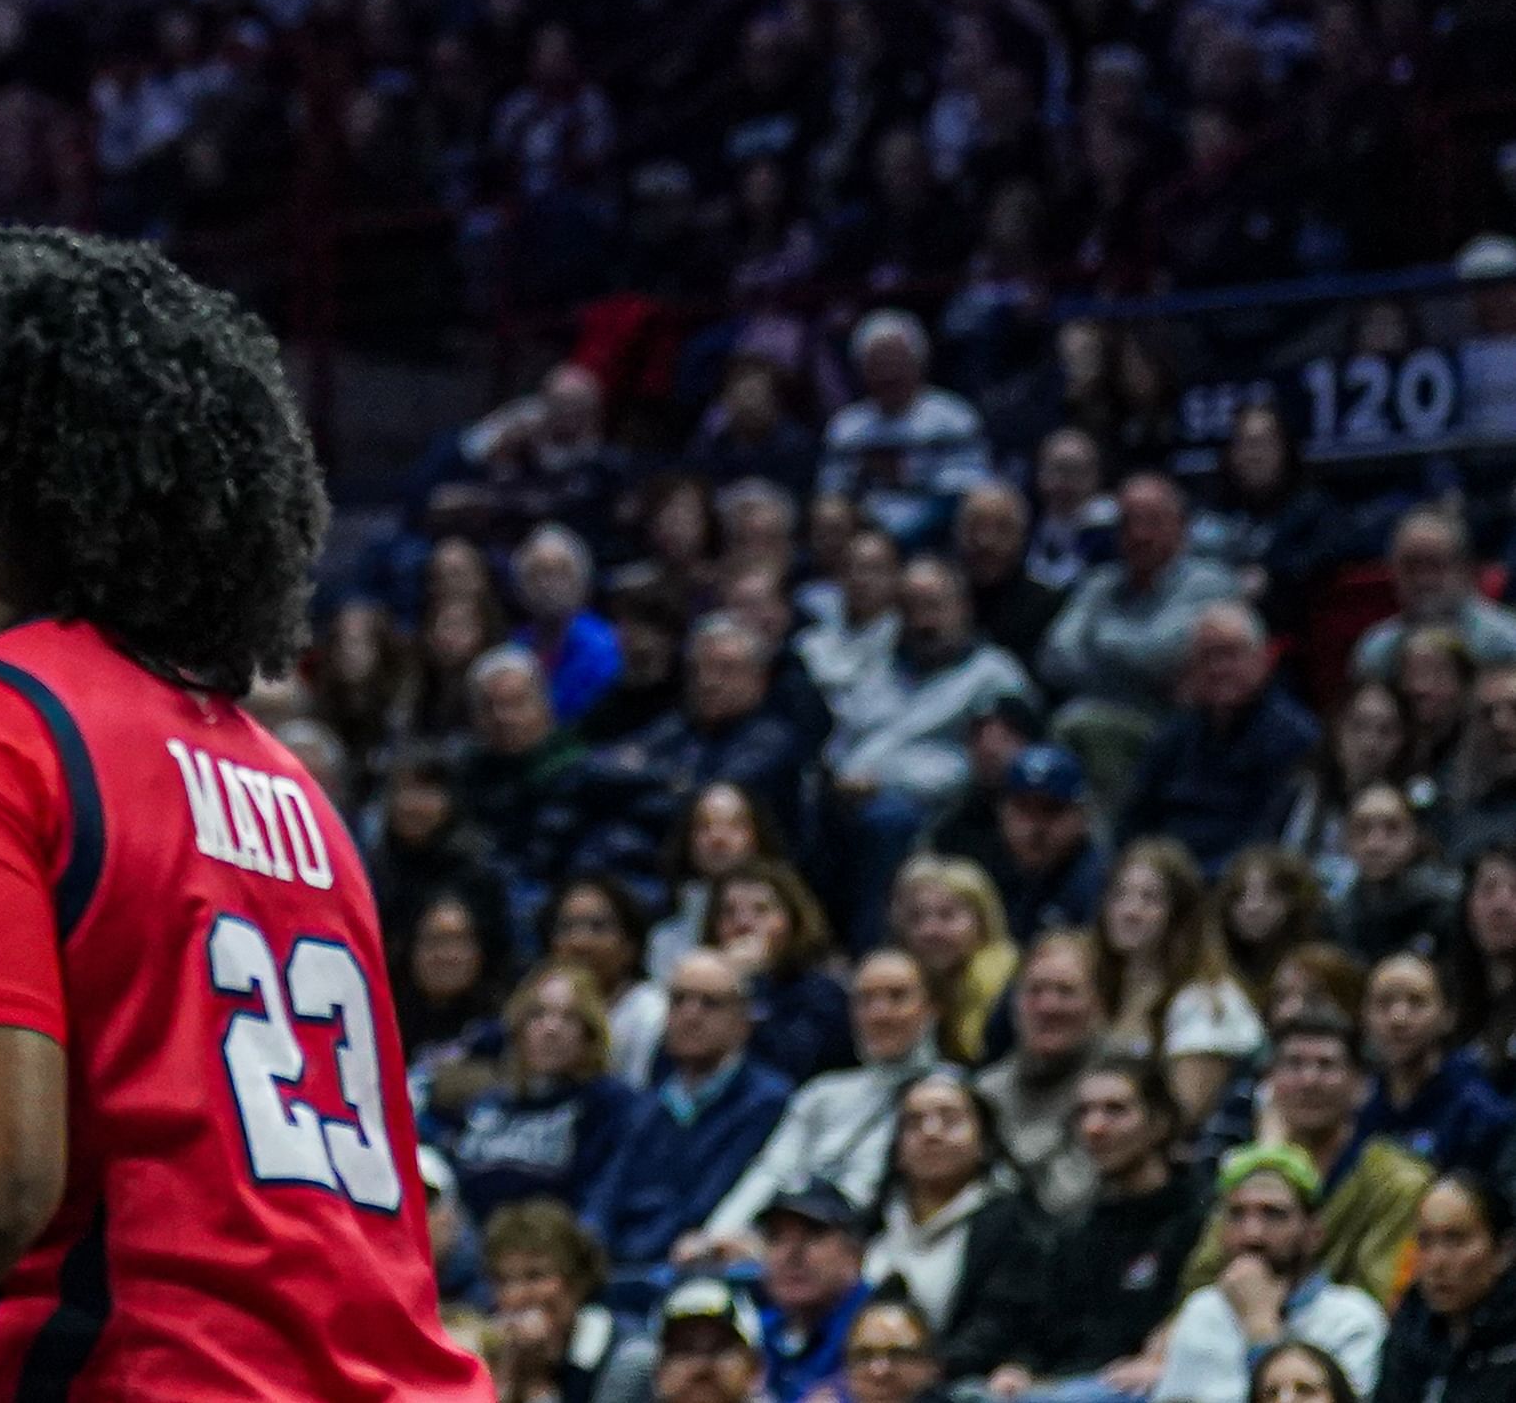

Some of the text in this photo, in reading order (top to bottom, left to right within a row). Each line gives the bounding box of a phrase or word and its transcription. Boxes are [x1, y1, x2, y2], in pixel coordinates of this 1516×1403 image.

[1299, 347, 1455, 447] 120
[166, 738, 333, 891] MAYO
[206, 913, 403, 1216] 23
